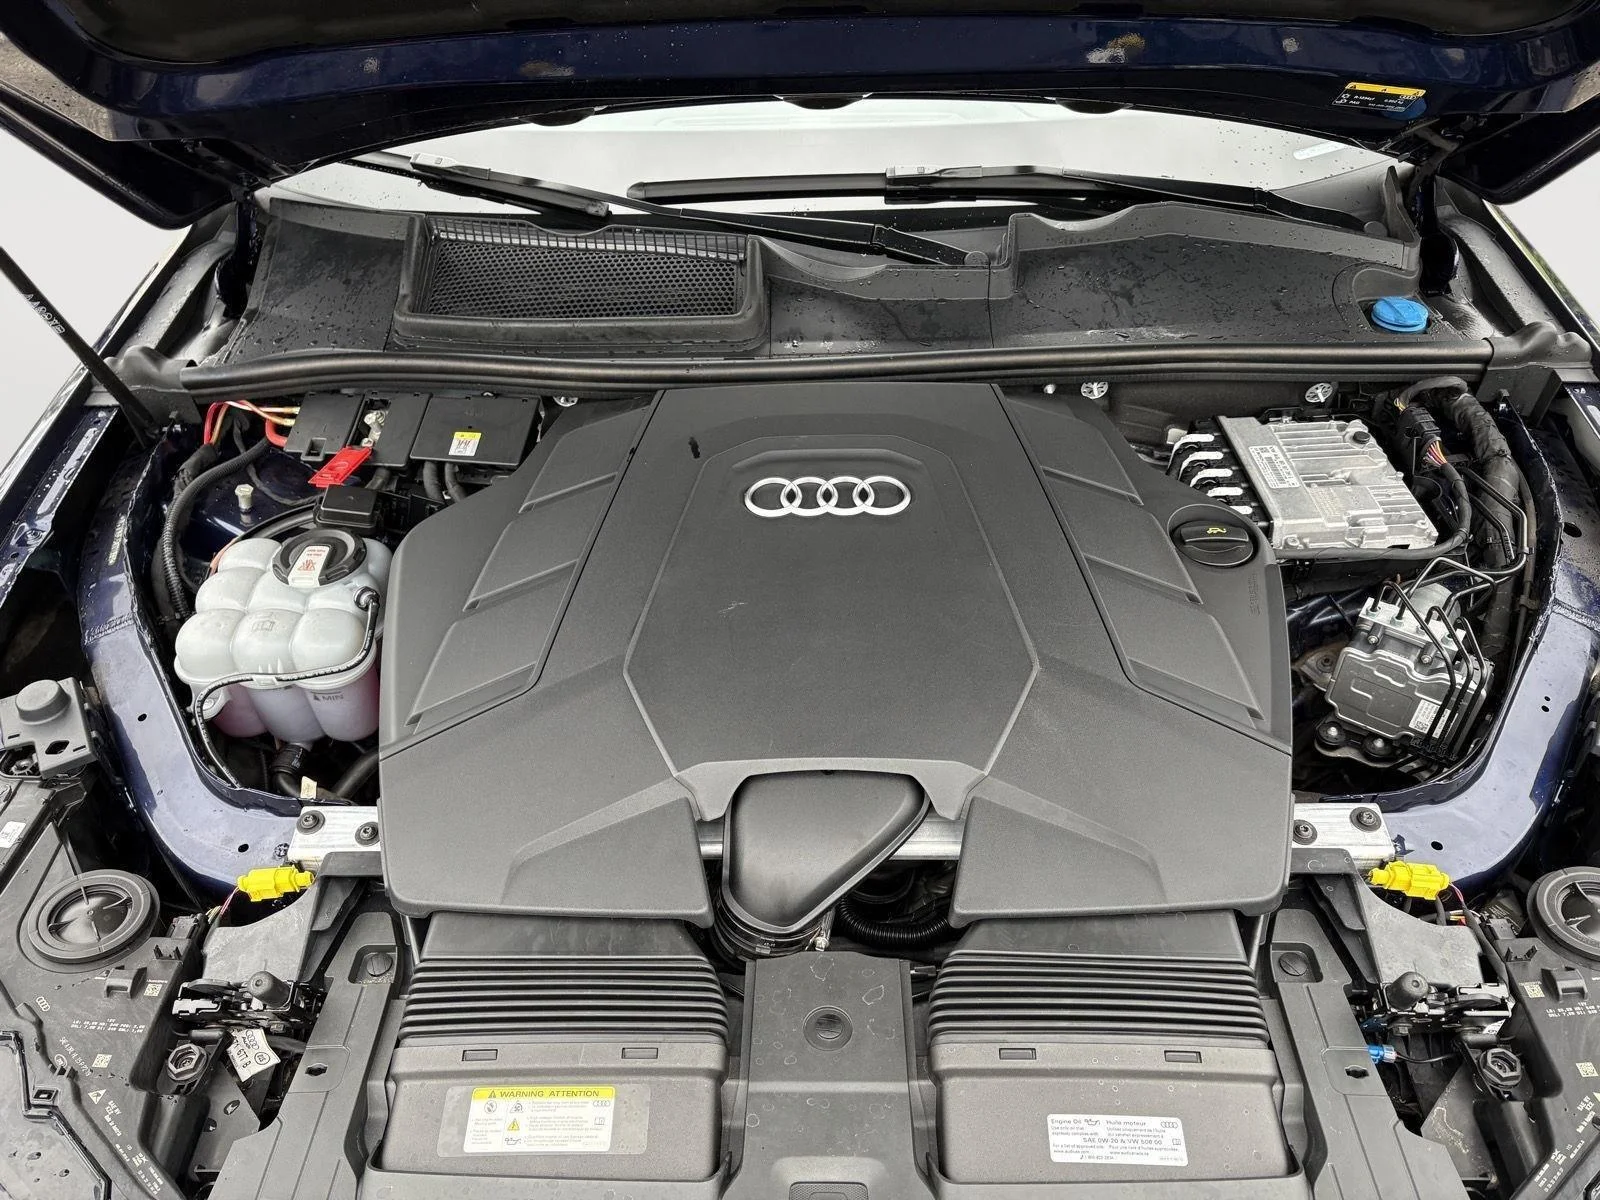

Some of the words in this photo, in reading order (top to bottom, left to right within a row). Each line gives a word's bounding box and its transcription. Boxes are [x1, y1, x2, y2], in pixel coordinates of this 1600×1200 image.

[500, 1090, 544, 1098] WARNING
[549, 1090, 600, 1098] ATTENTION
[1050, 1118, 1072, 1126] Engine
